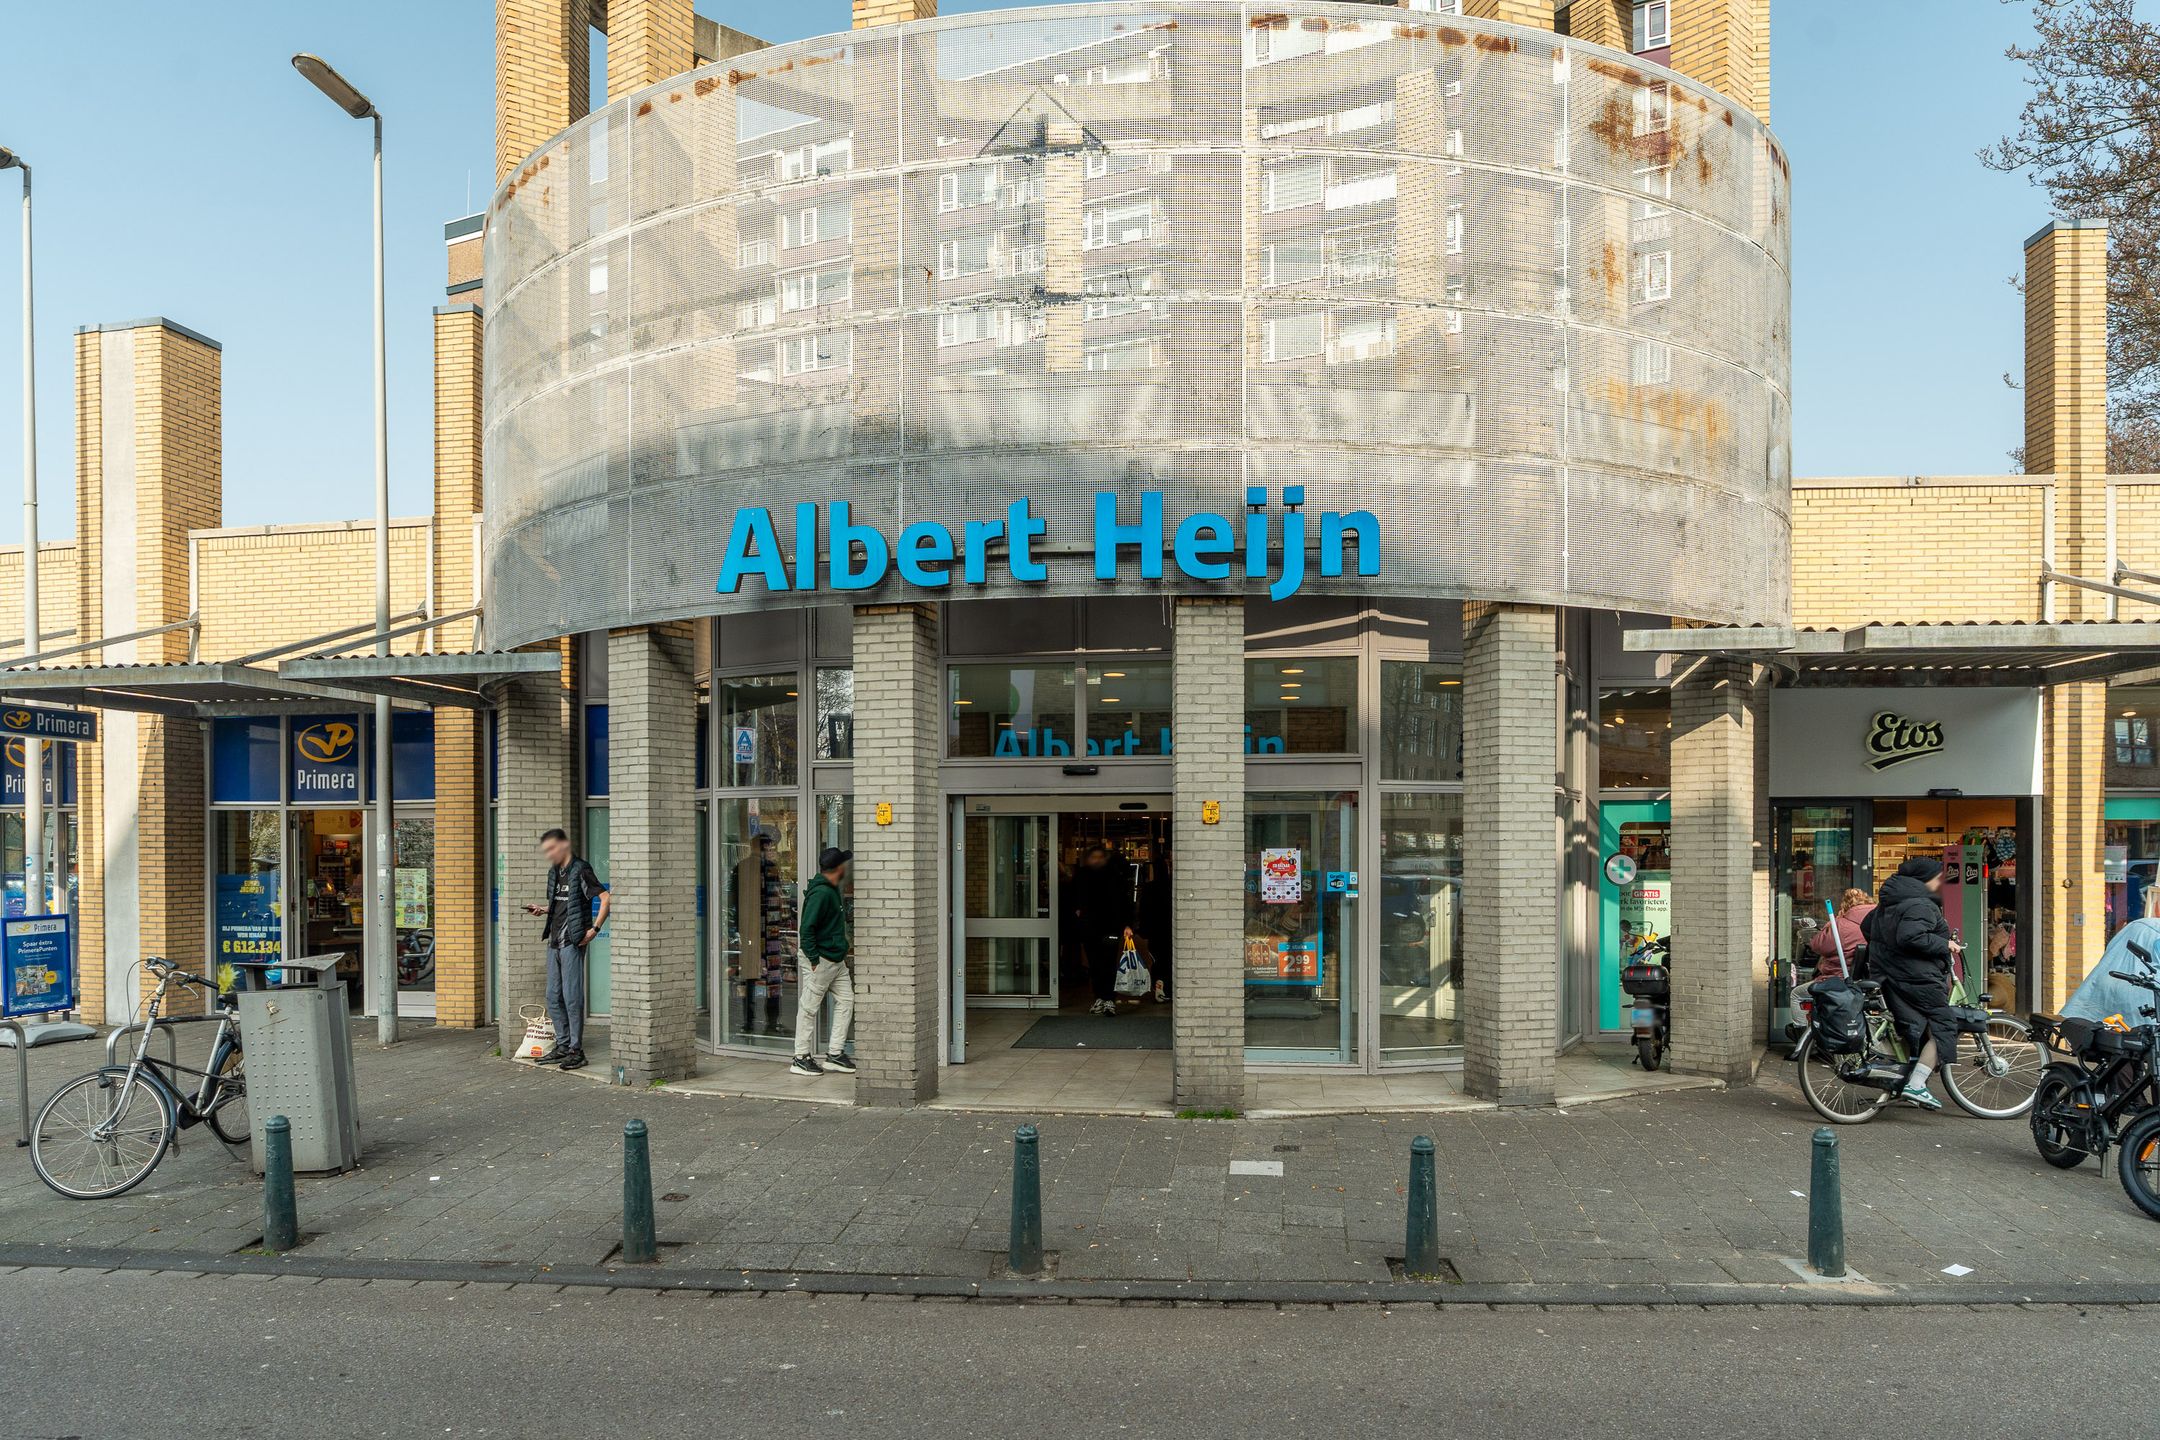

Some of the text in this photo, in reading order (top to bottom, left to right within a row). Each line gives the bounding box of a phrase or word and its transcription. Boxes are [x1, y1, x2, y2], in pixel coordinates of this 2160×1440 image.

[716, 485, 1380, 602] Albert Heijn
[36, 712, 90, 735] Primera
[1870, 712, 1945, 753] Etos
[297, 769, 355, 790] Primera
[34, 923, 57, 932] Primera
[223, 940, 231, 953] €
